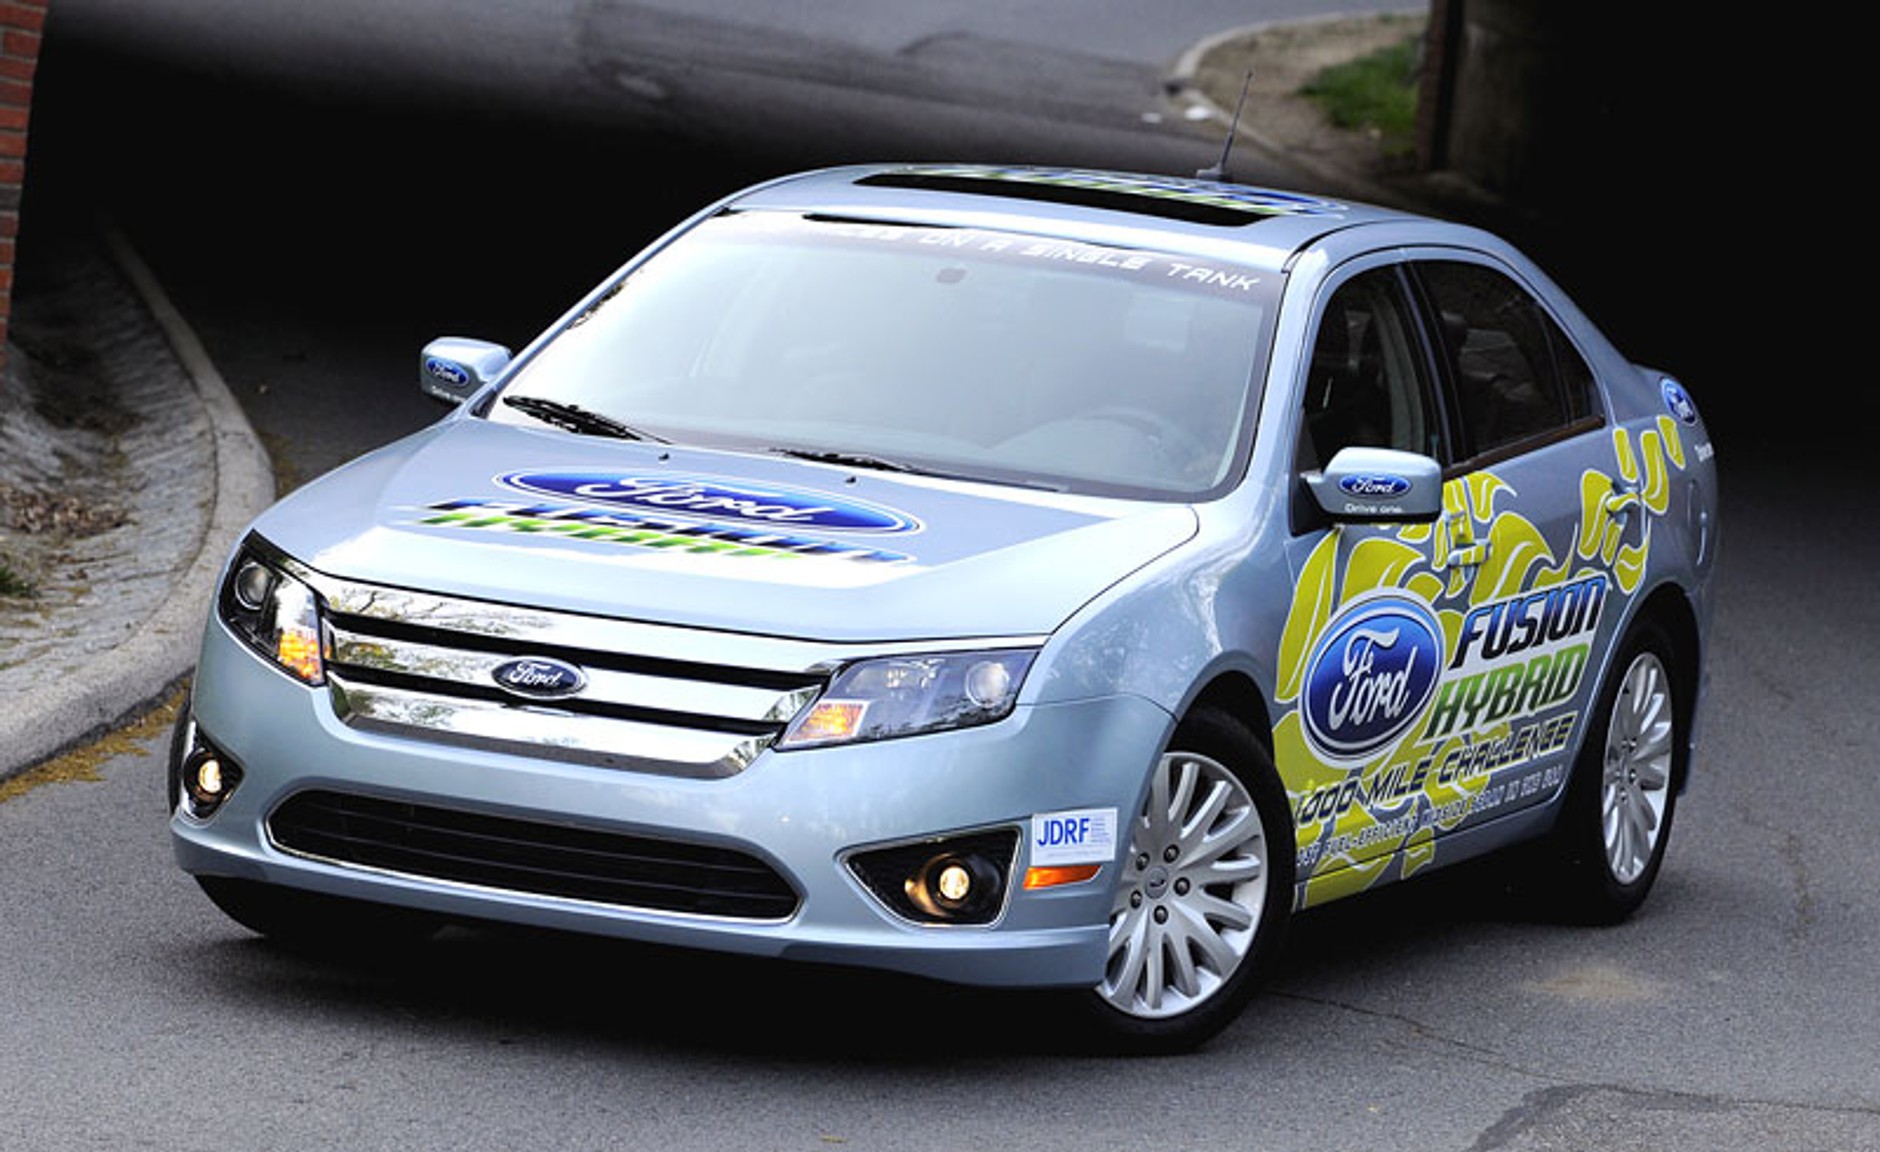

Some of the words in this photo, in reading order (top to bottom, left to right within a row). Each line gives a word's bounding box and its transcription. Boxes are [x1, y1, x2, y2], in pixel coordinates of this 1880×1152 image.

[1020, 243, 1151, 270] SINGLE
[1167, 262, 1260, 290] TANK
[575, 476, 837, 521] Ford
[1351, 475, 1396, 493] Ford
[1344, 502, 1377, 513] Drive
[1448, 576, 1606, 670] FUSION
[509, 660, 563, 686] Ford
[1328, 627, 1418, 731] Ford
[1421, 643, 1590, 740] HYBRID
[1367, 759, 1433, 805] MILE
[1437, 714, 1578, 785] CHALLENGE
[1037, 818, 1090, 846] JDRF
